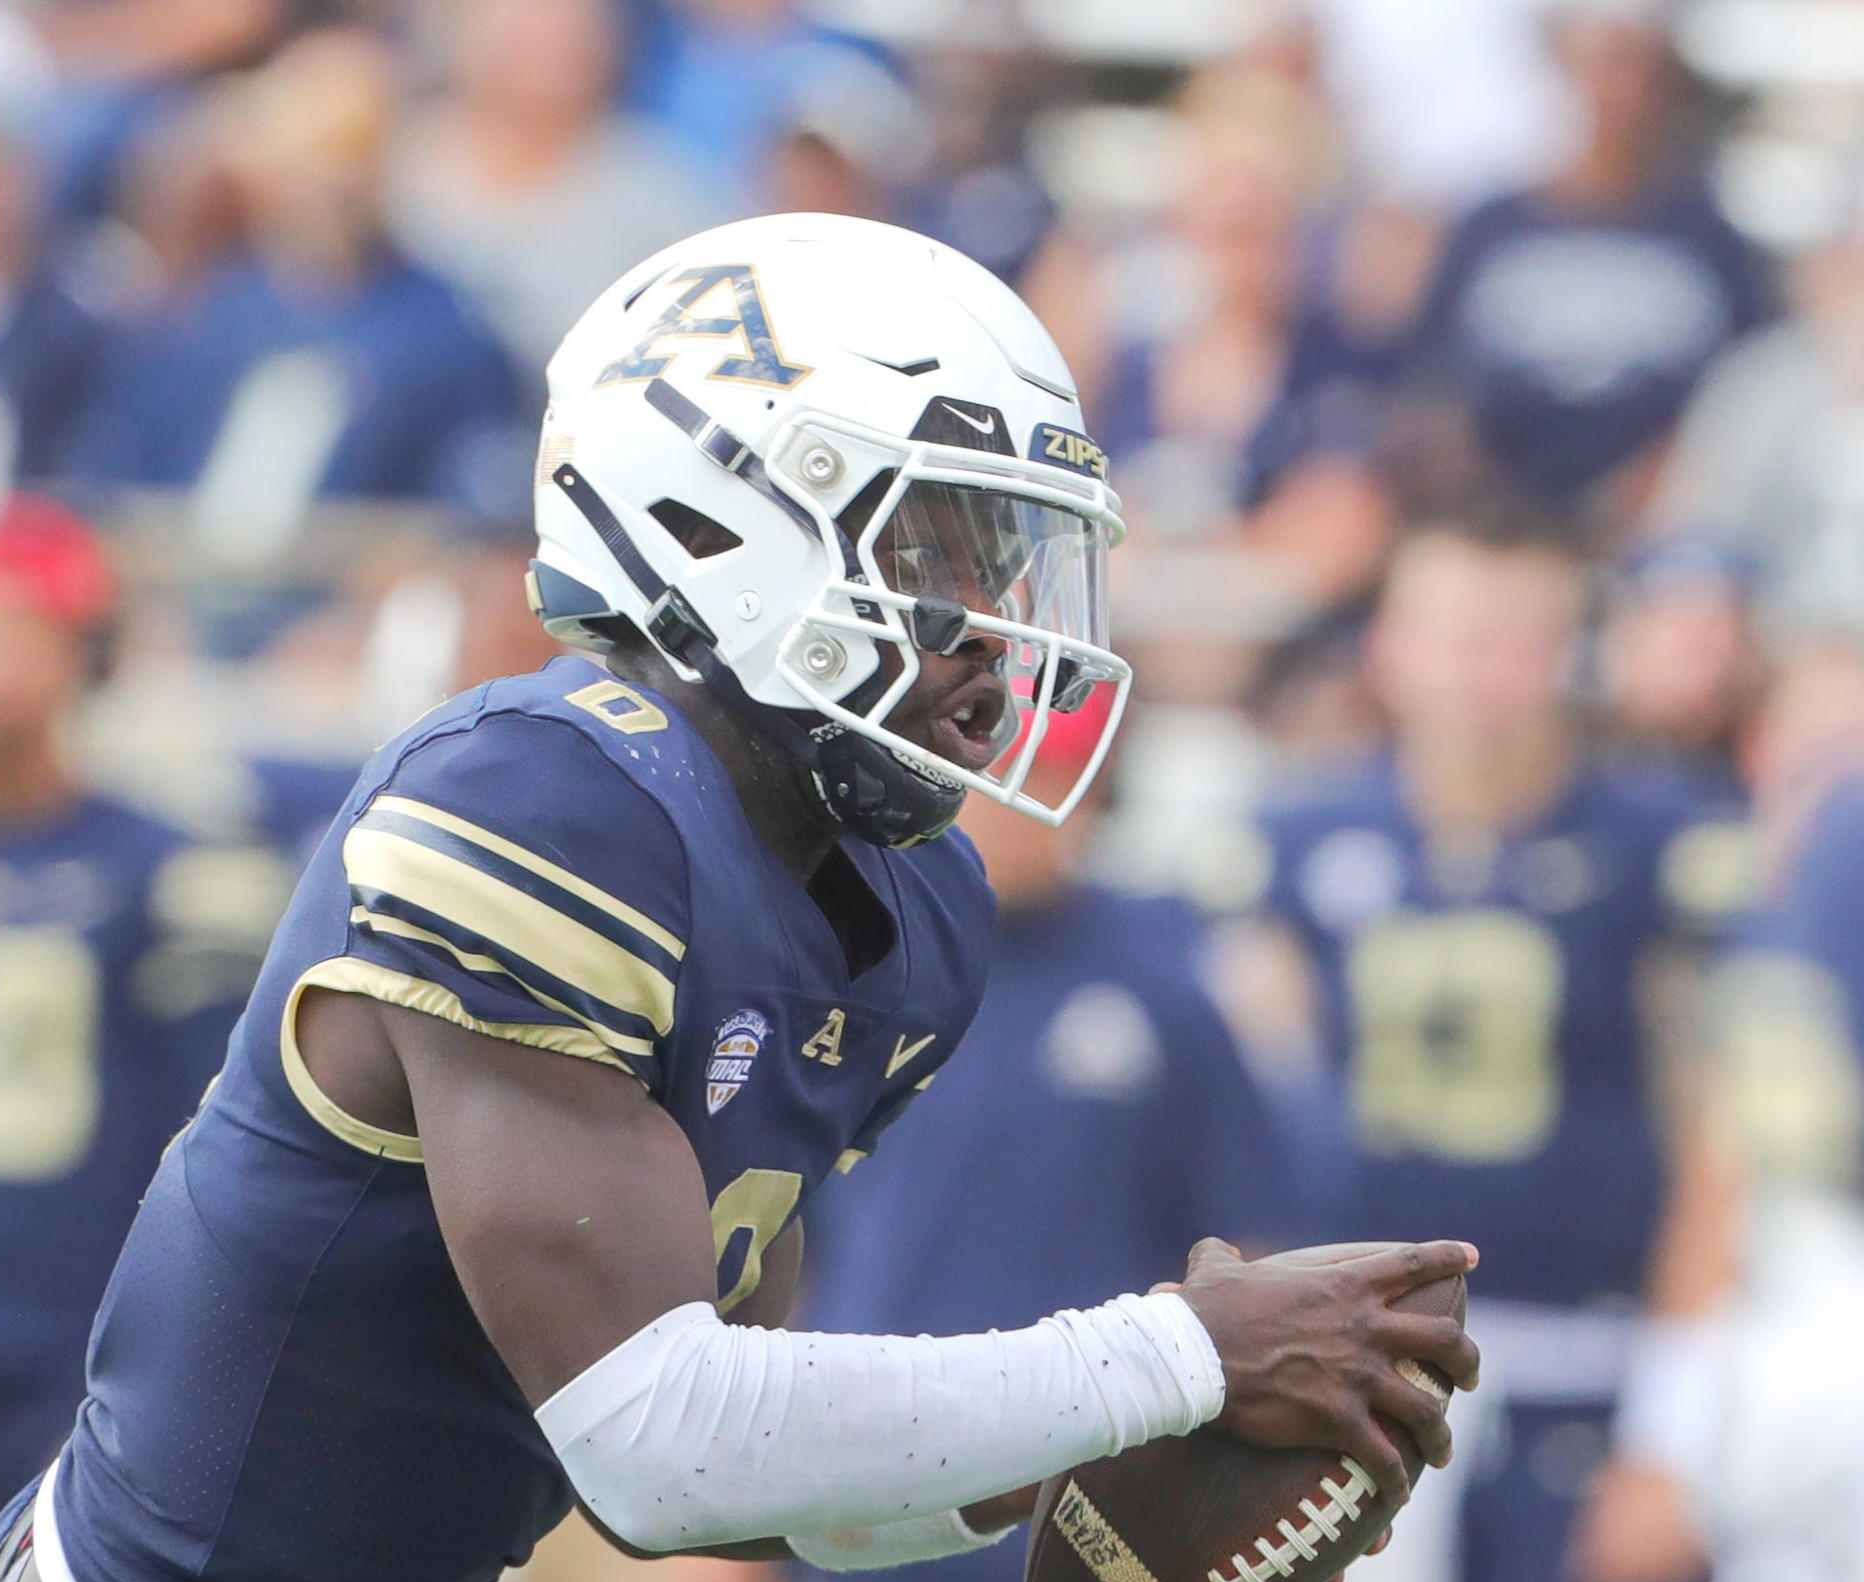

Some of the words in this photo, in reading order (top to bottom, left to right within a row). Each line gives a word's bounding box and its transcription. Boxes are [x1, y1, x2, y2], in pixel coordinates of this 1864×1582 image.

[1042, 428, 1106, 476] ZIPS
[801, 1008, 848, 1067] A
[706, 1058, 753, 1082] MAC
